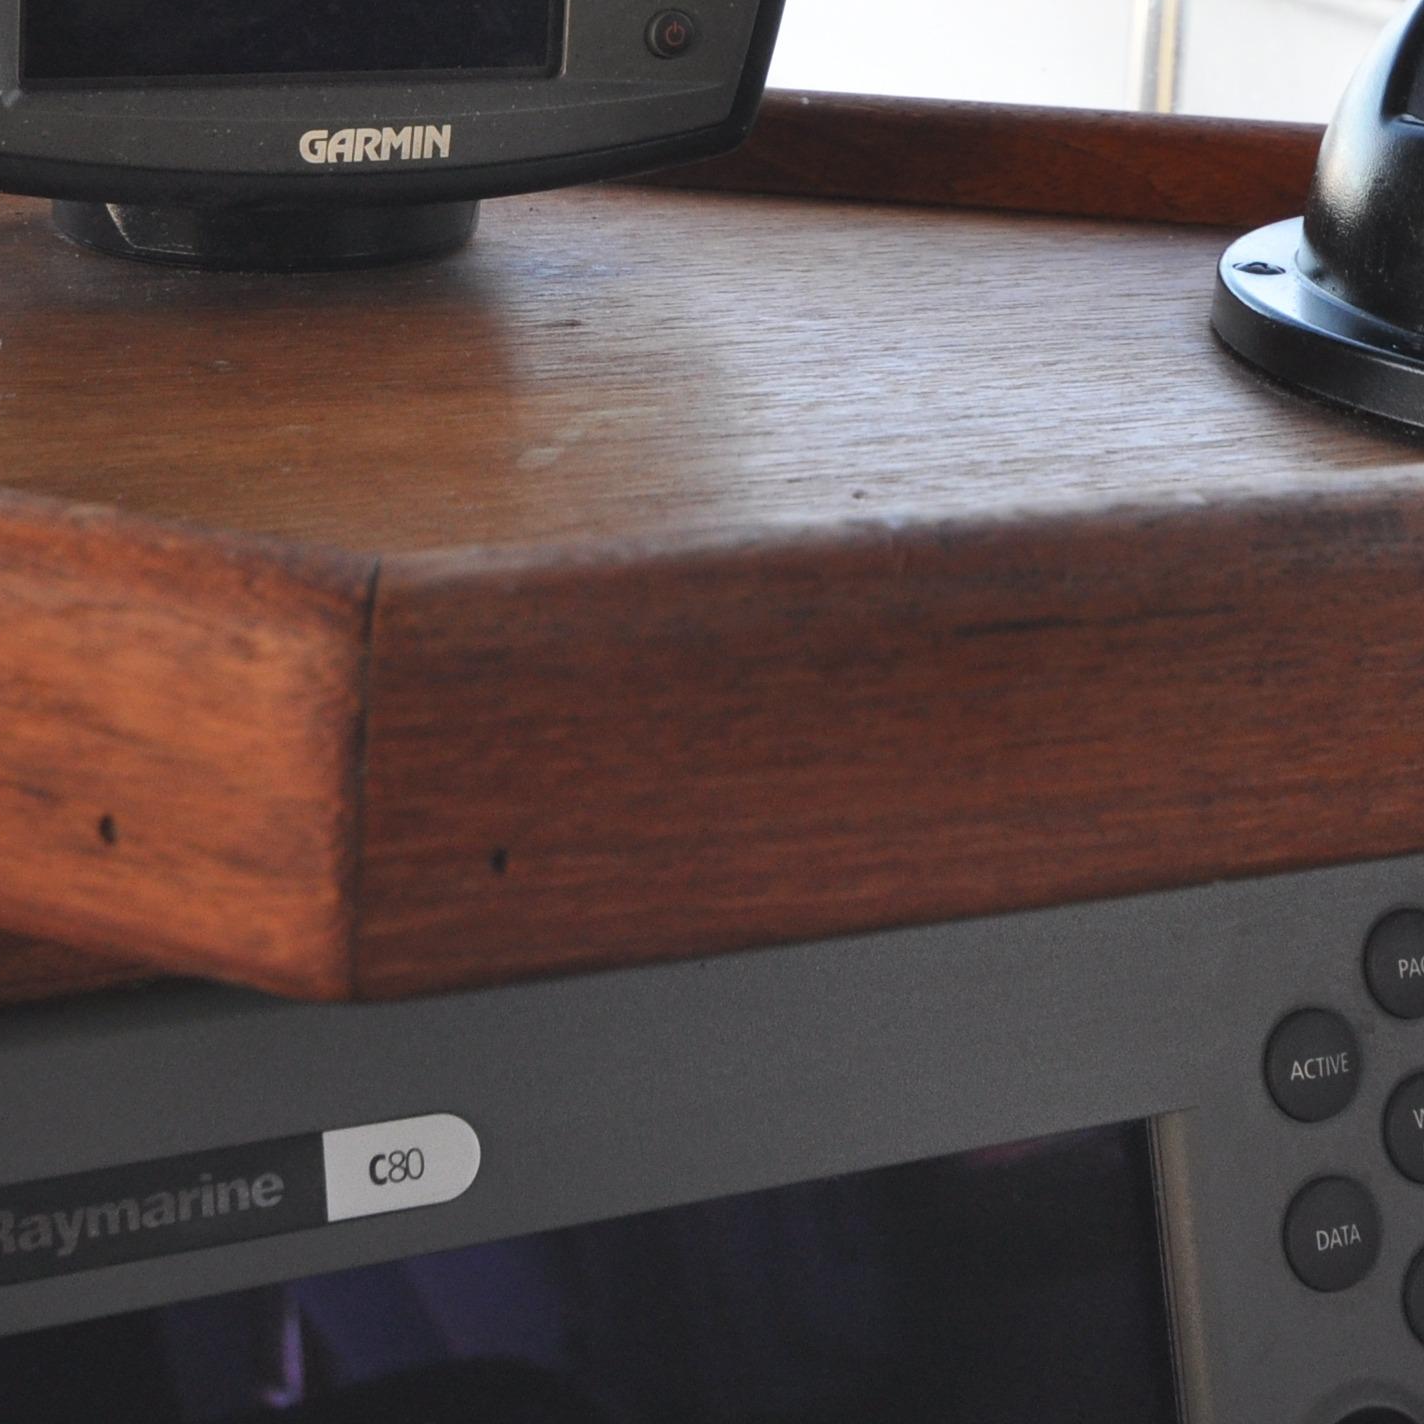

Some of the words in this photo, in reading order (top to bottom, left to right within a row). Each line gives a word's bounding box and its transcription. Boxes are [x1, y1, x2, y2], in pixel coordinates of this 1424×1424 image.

[299, 124, 452, 164] GARMIN
[1290, 1051, 1350, 1081] ACTIVE
[369, 1147, 426, 1186] C80
[1316, 1223, 1362, 1251] DATA
